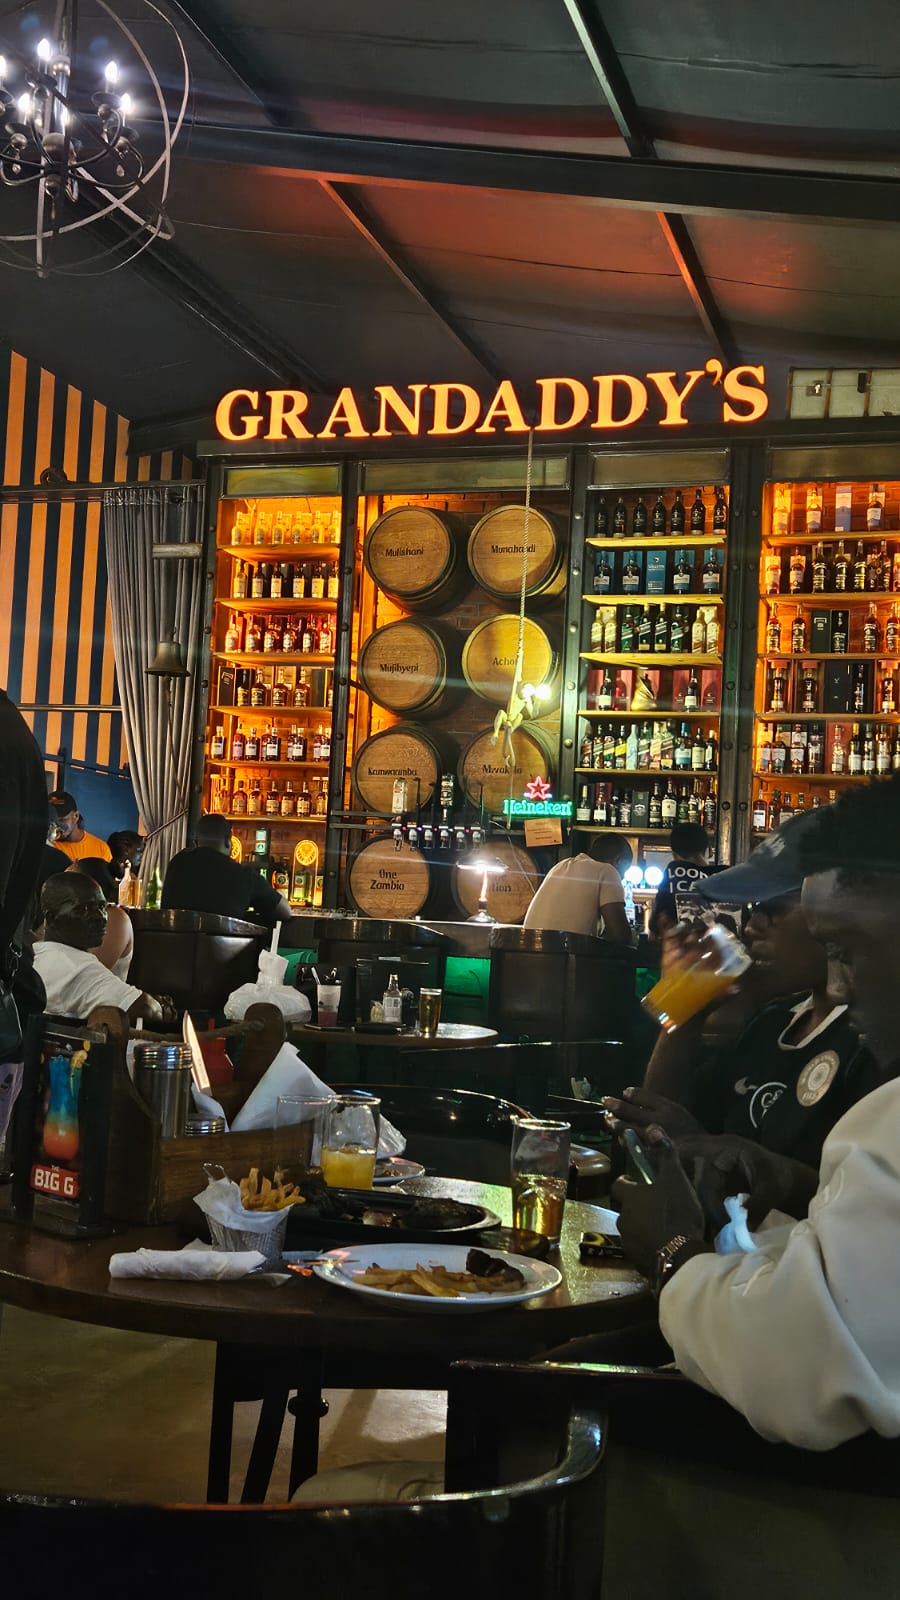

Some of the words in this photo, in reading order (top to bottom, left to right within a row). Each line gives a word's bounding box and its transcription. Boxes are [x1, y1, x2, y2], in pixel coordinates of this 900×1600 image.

[214, 358, 770, 441] GRANDADDY'S
[503, 799, 572, 816] Heineken
[379, 868, 398, 879] One
[370, 879, 405, 891] Zambia
[34, 1168, 60, 1190] BIG
[64, 1176, 74, 1195] G
